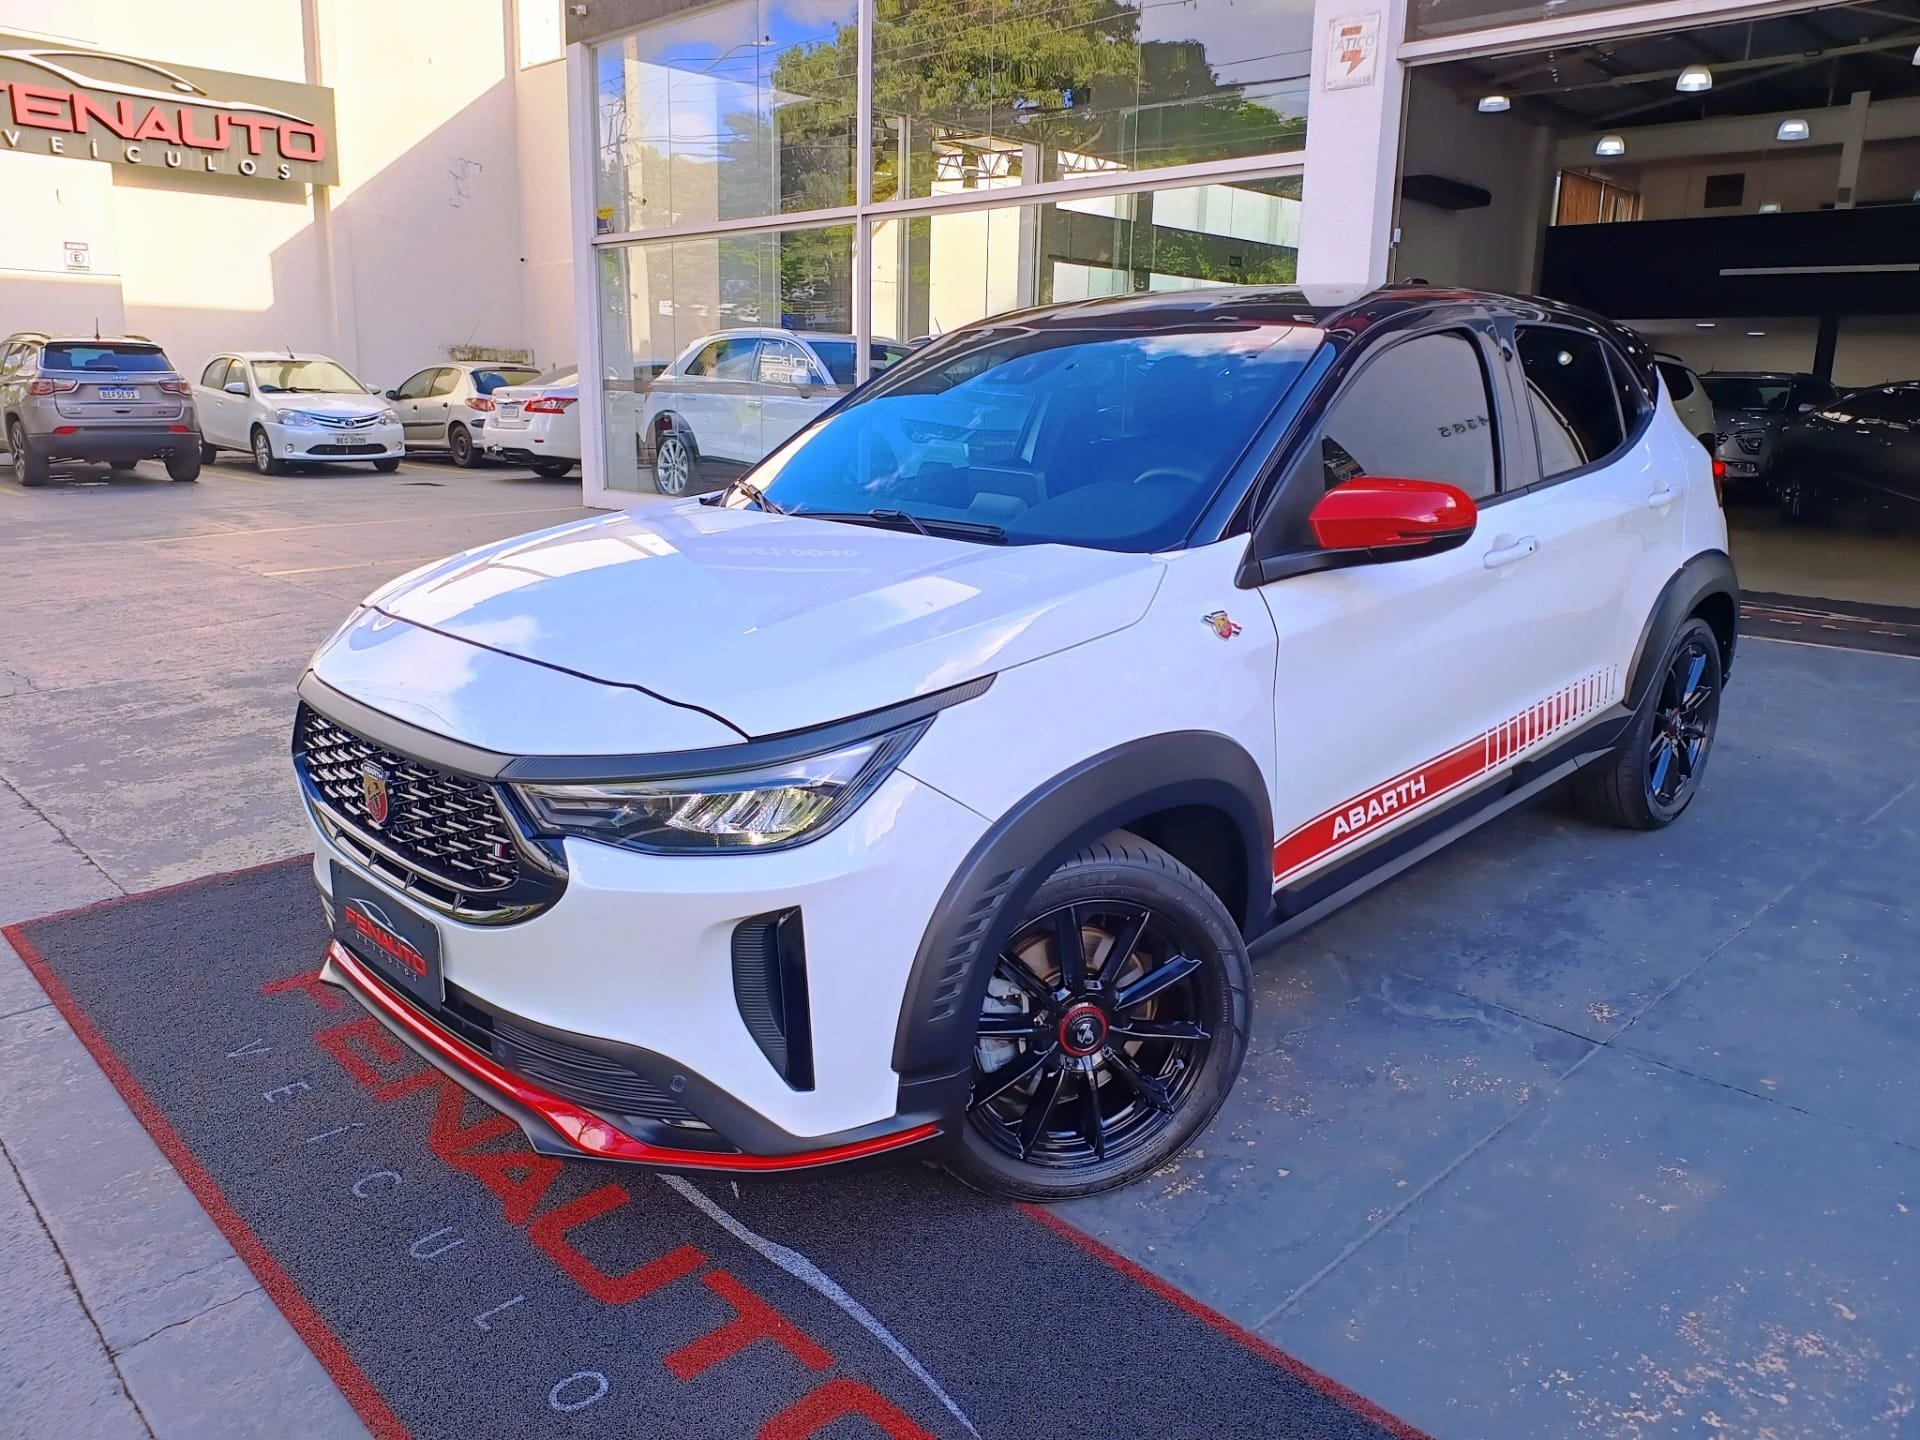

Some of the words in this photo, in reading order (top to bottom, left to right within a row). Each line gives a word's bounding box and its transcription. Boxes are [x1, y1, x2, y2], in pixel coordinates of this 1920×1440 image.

[0, 80, 326, 163] ENAUTO
[1332, 774, 1426, 841] ABARTH
[344, 905, 427, 977] FENAUTO
